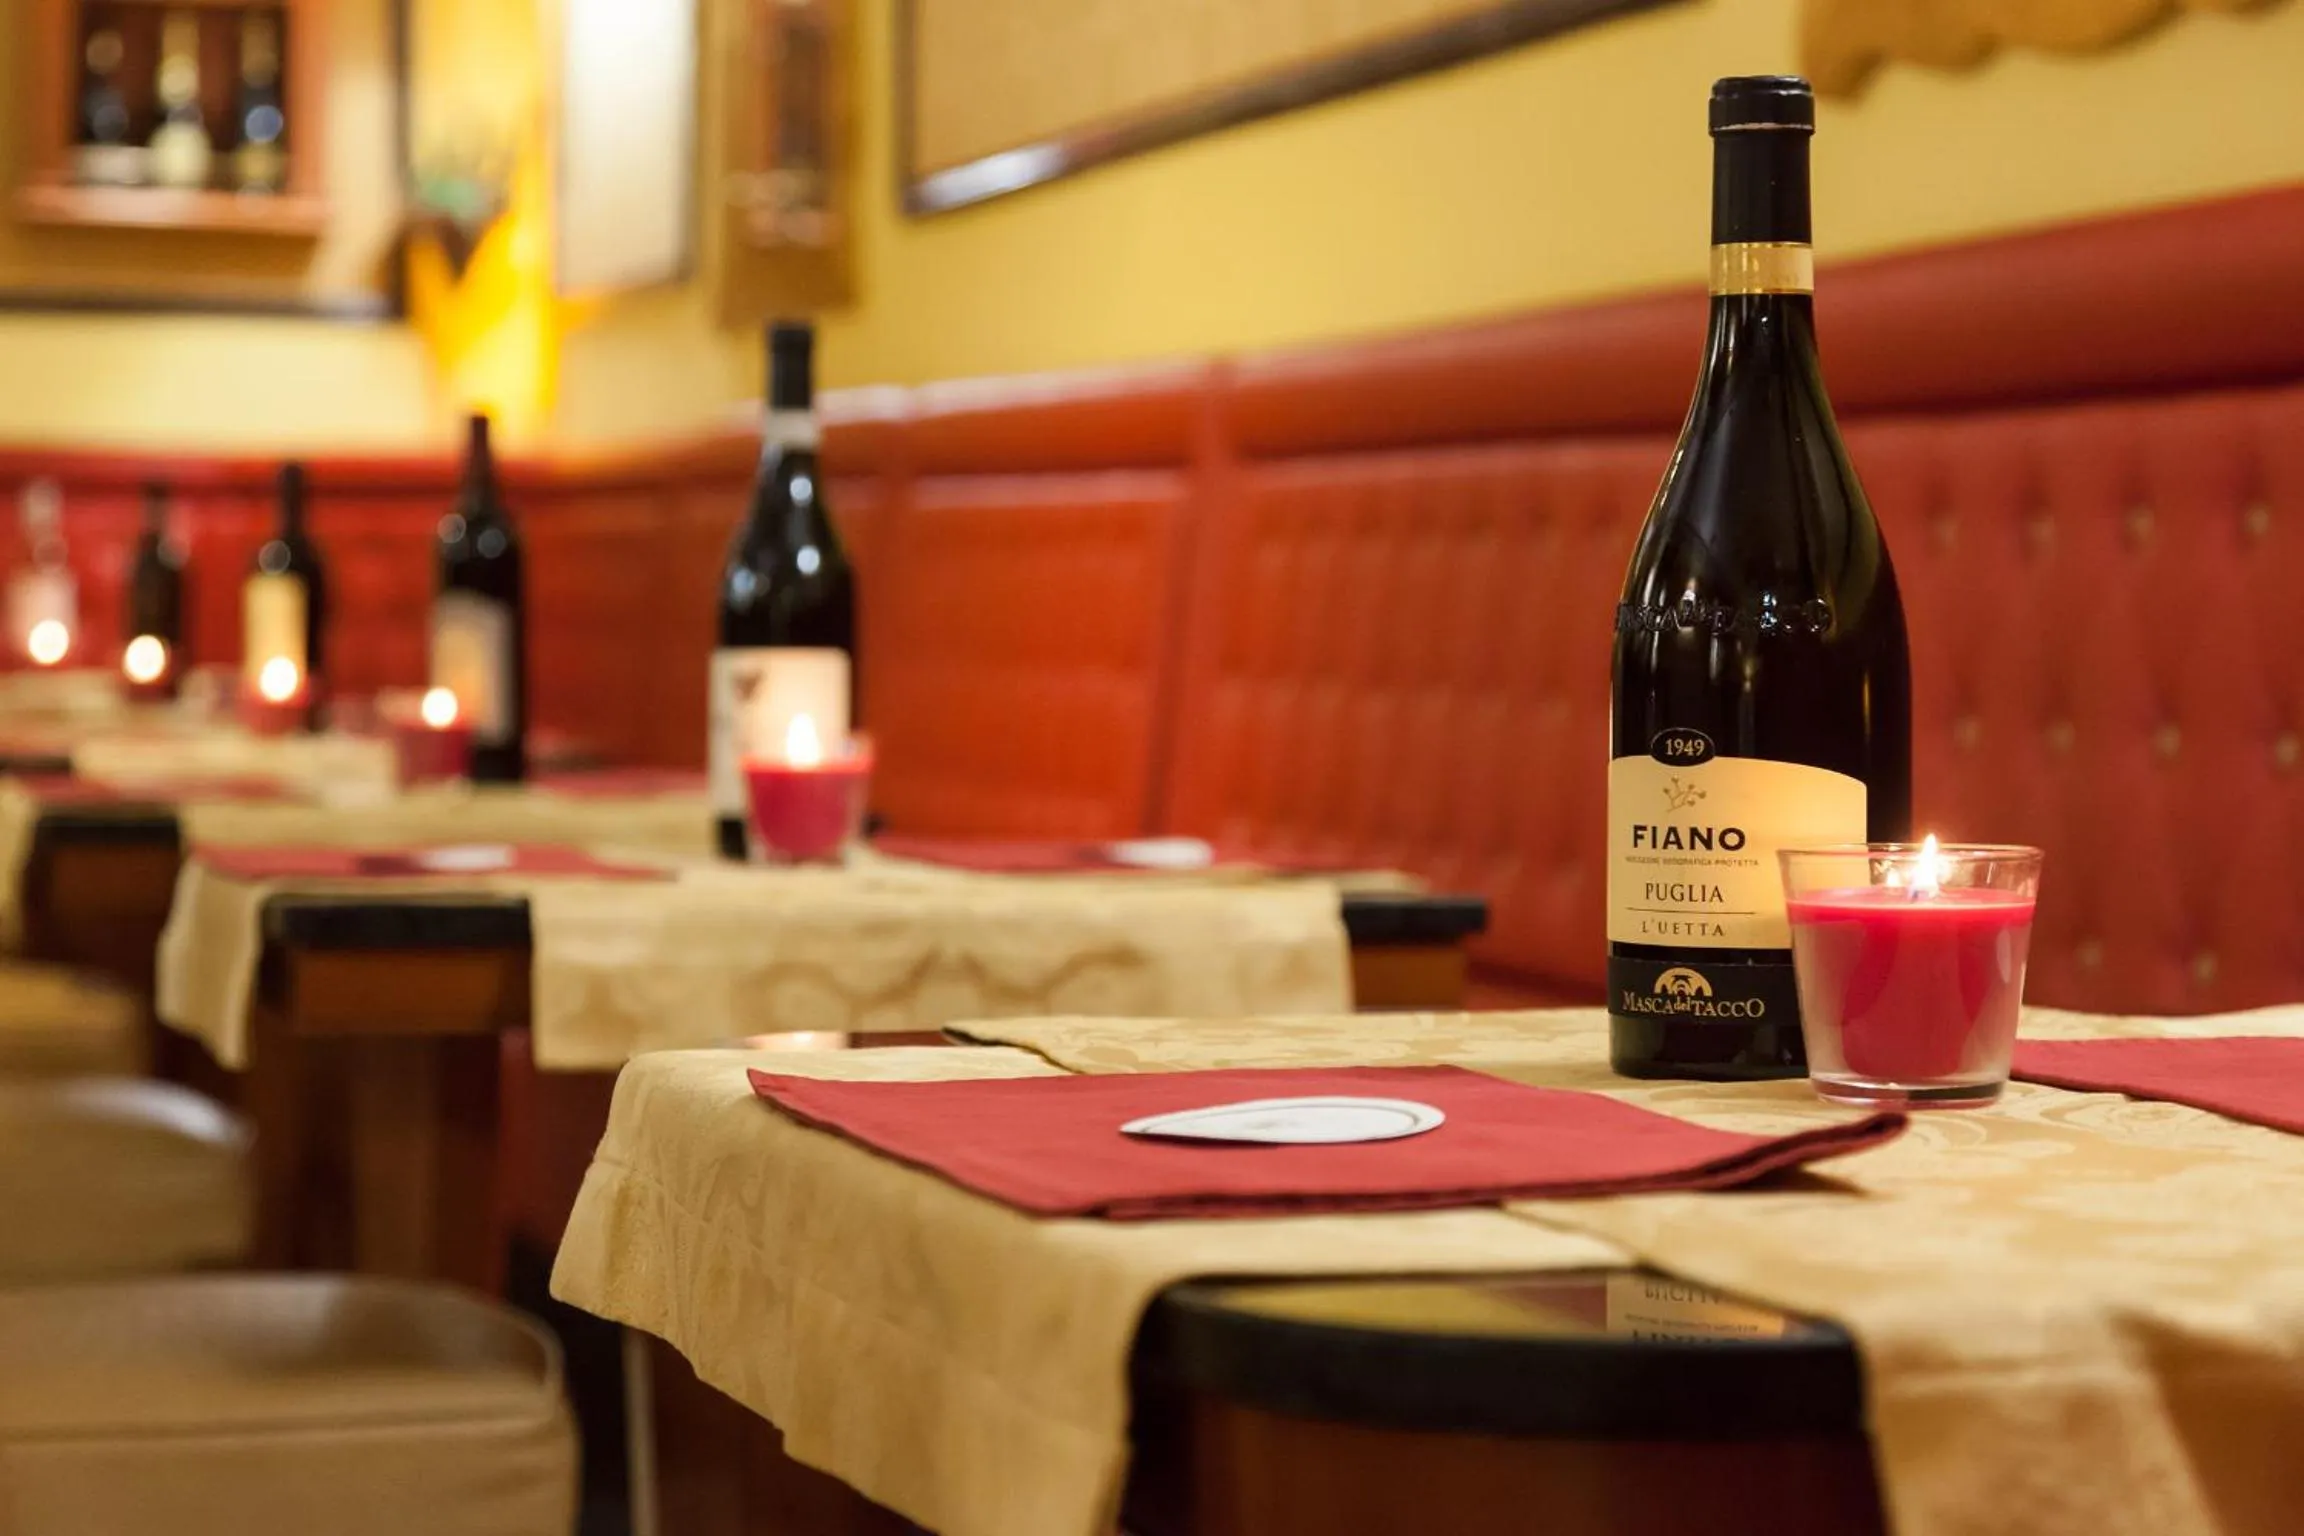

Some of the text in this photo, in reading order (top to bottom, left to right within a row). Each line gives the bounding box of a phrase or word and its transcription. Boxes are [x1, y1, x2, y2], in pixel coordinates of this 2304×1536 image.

[1665, 738, 1705, 756] 1949
[1633, 824, 1746, 851] FIANO
[1645, 882, 1724, 903] PUGLIA
[1641, 917, 1726, 937] L'UETTA
